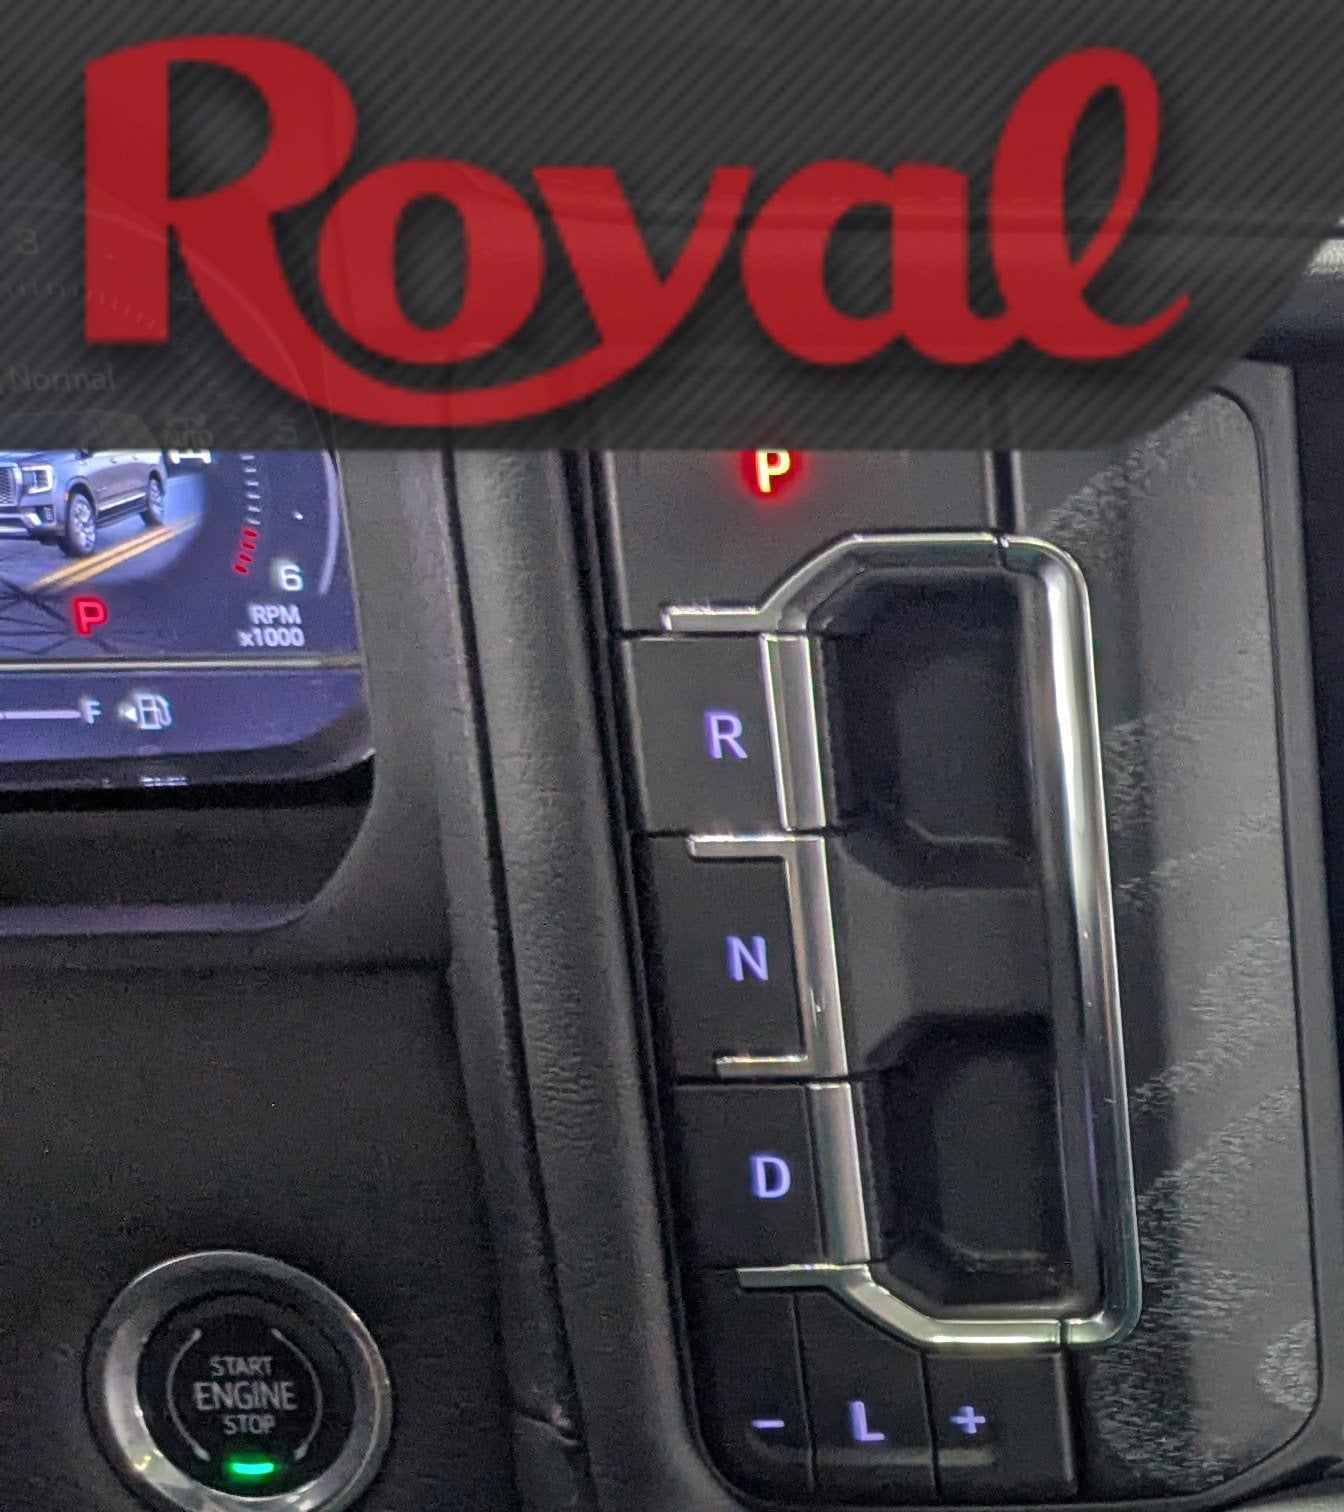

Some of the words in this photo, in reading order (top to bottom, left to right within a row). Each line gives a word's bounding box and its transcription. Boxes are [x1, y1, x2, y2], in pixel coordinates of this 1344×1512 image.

[755, 448, 791, 493] P
[276, 563, 304, 592] 6
[73, 597, 108, 636] P
[248, 604, 302, 625] RPM
[238, 627, 305, 647] x1000
[80, 699, 100, 724] F
[706, 709, 748, 760] R
[726, 936, 770, 982] N
[752, 1154, 792, 1200] D
[209, 1356, 274, 1377] START
[192, 1381, 298, 1411] ENGINE
[222, 1415, 277, 1436] STOP
[849, 1400, 886, 1442] L
